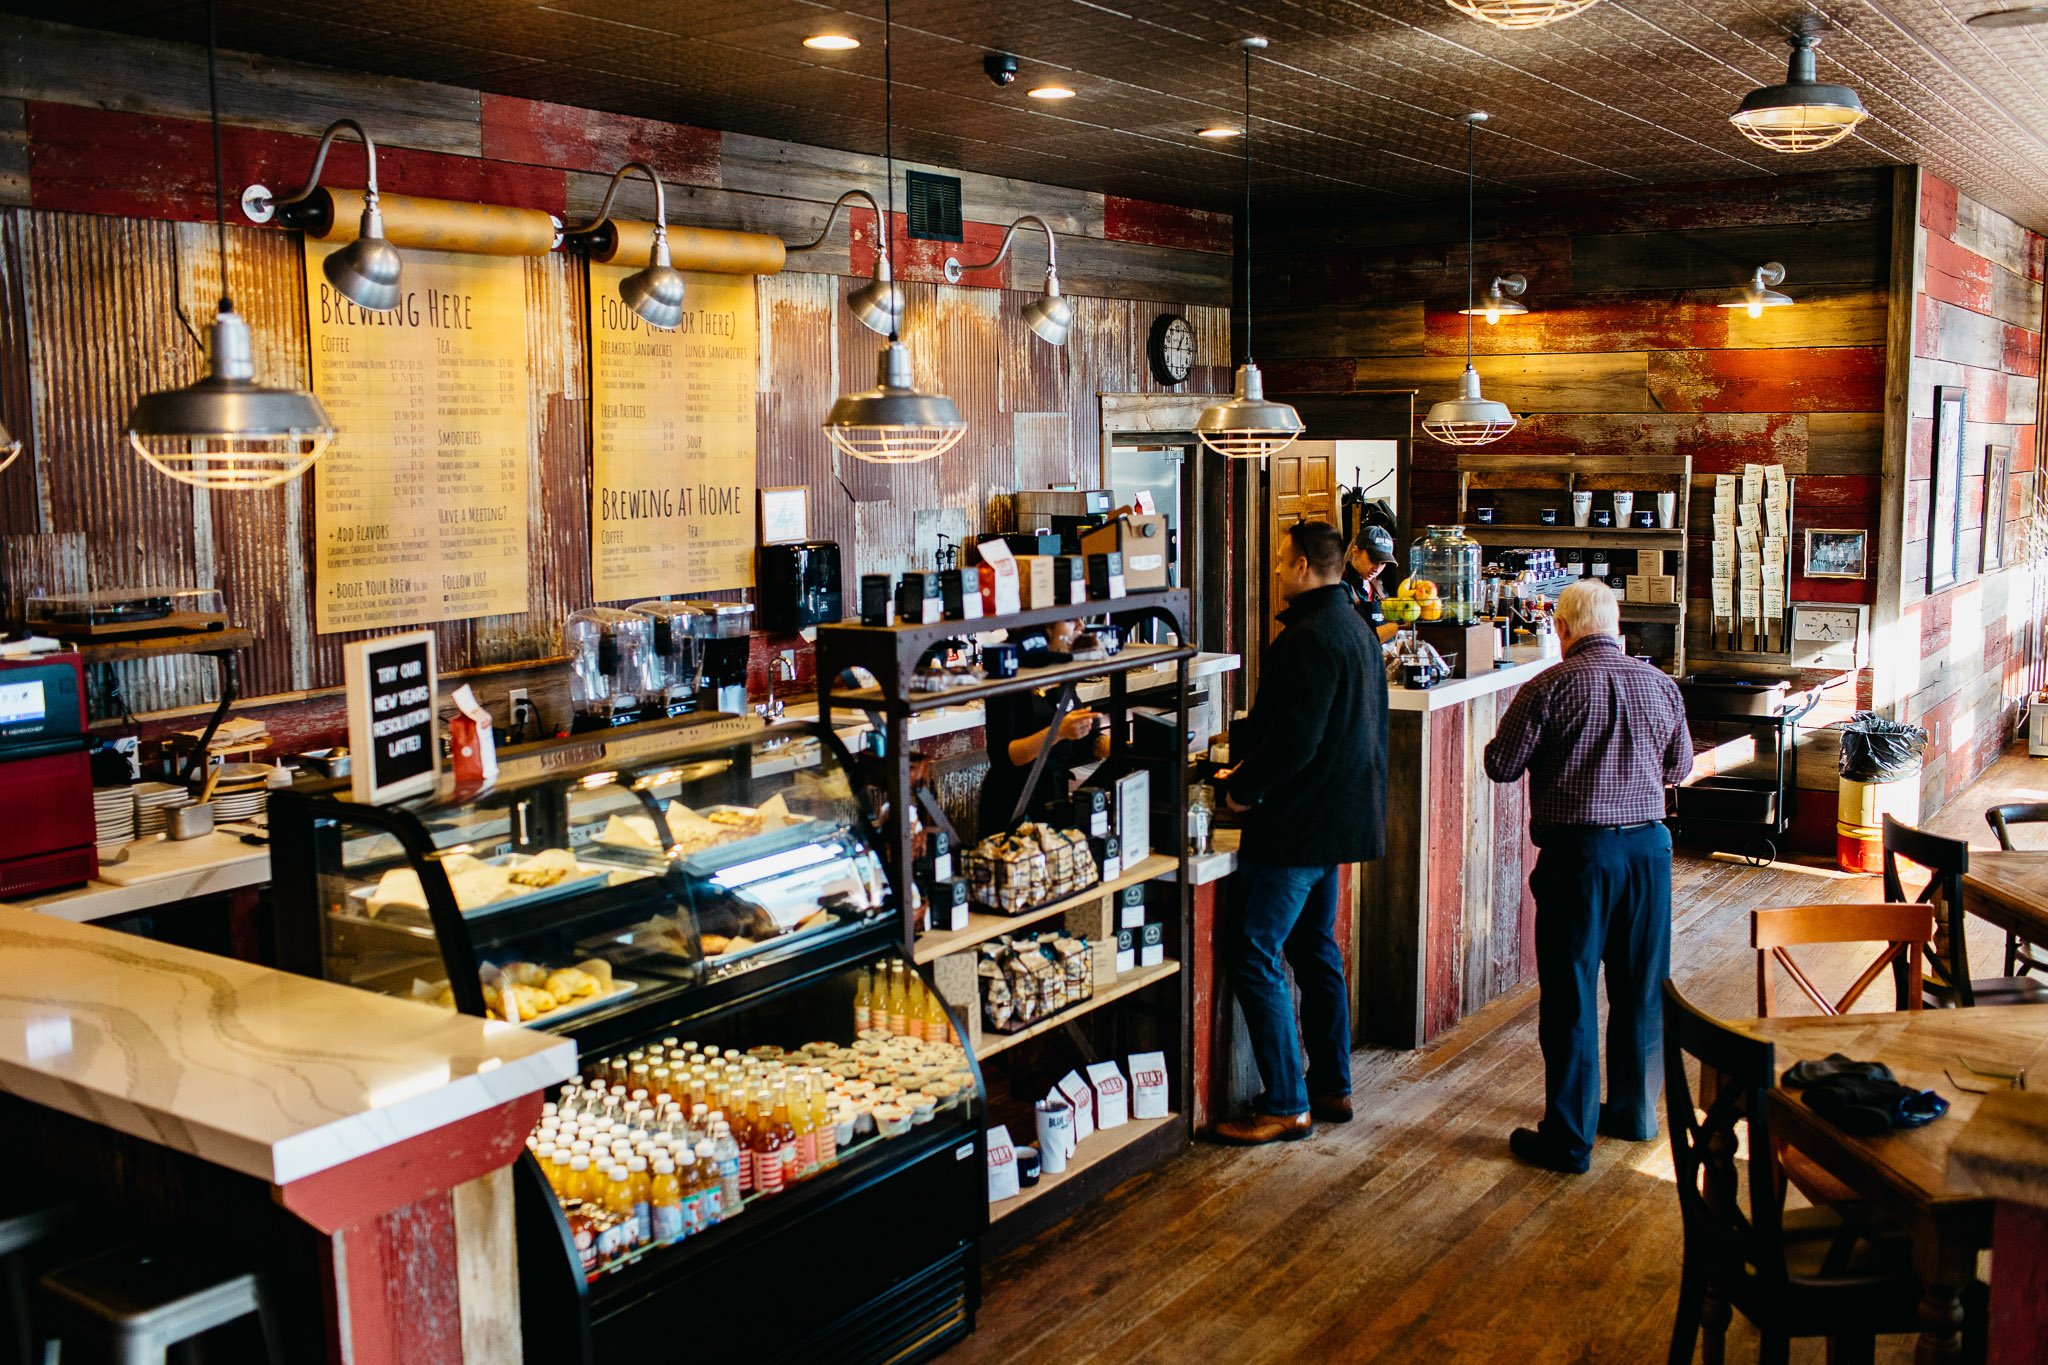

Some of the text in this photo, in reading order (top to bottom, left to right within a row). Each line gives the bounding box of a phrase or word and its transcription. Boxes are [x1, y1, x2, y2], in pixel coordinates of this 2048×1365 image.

[428, 289, 473, 330] HERE
[600, 295, 639, 331] FOOD
[682, 311, 695, 335] OR
[699, 309, 736, 340] THERE)
[321, 334, 350, 353] COFFEE
[436, 337, 450, 354] TEA
[600, 340, 673, 358] BREAKFAST SANDWICHES
[685, 343, 748, 361] LUNCH SANDWICHES
[601, 403, 646, 419] FRESH PASTRIES
[438, 429, 481, 446] SMOOTHIES
[687, 434, 703, 450] SOUP
[602, 483, 742, 521] BREWING AT HOME
[438, 505, 507, 524] HAVE A MEETING?
[337, 526, 354, 542] ADD
[357, 524, 389, 541] FLAVORS
[601, 529, 624, 545] COFFEE
[687, 524, 699, 539] TEA
[336, 582, 363, 599] BOOZE
[366, 580, 387, 596] YOUR
[390, 578, 411, 594] BREW
[442, 571, 487, 590] FOLLOW US!
[376, 660, 422, 684] TRY OUR
[374, 685, 429, 713] NEW YEARS
[373, 707, 431, 738] RESOLUTION
[1100, 1078, 1123, 1093] RUBY
[1138, 1071, 1162, 1086] RUBY
[1049, 1116, 1065, 1128] BLUE
